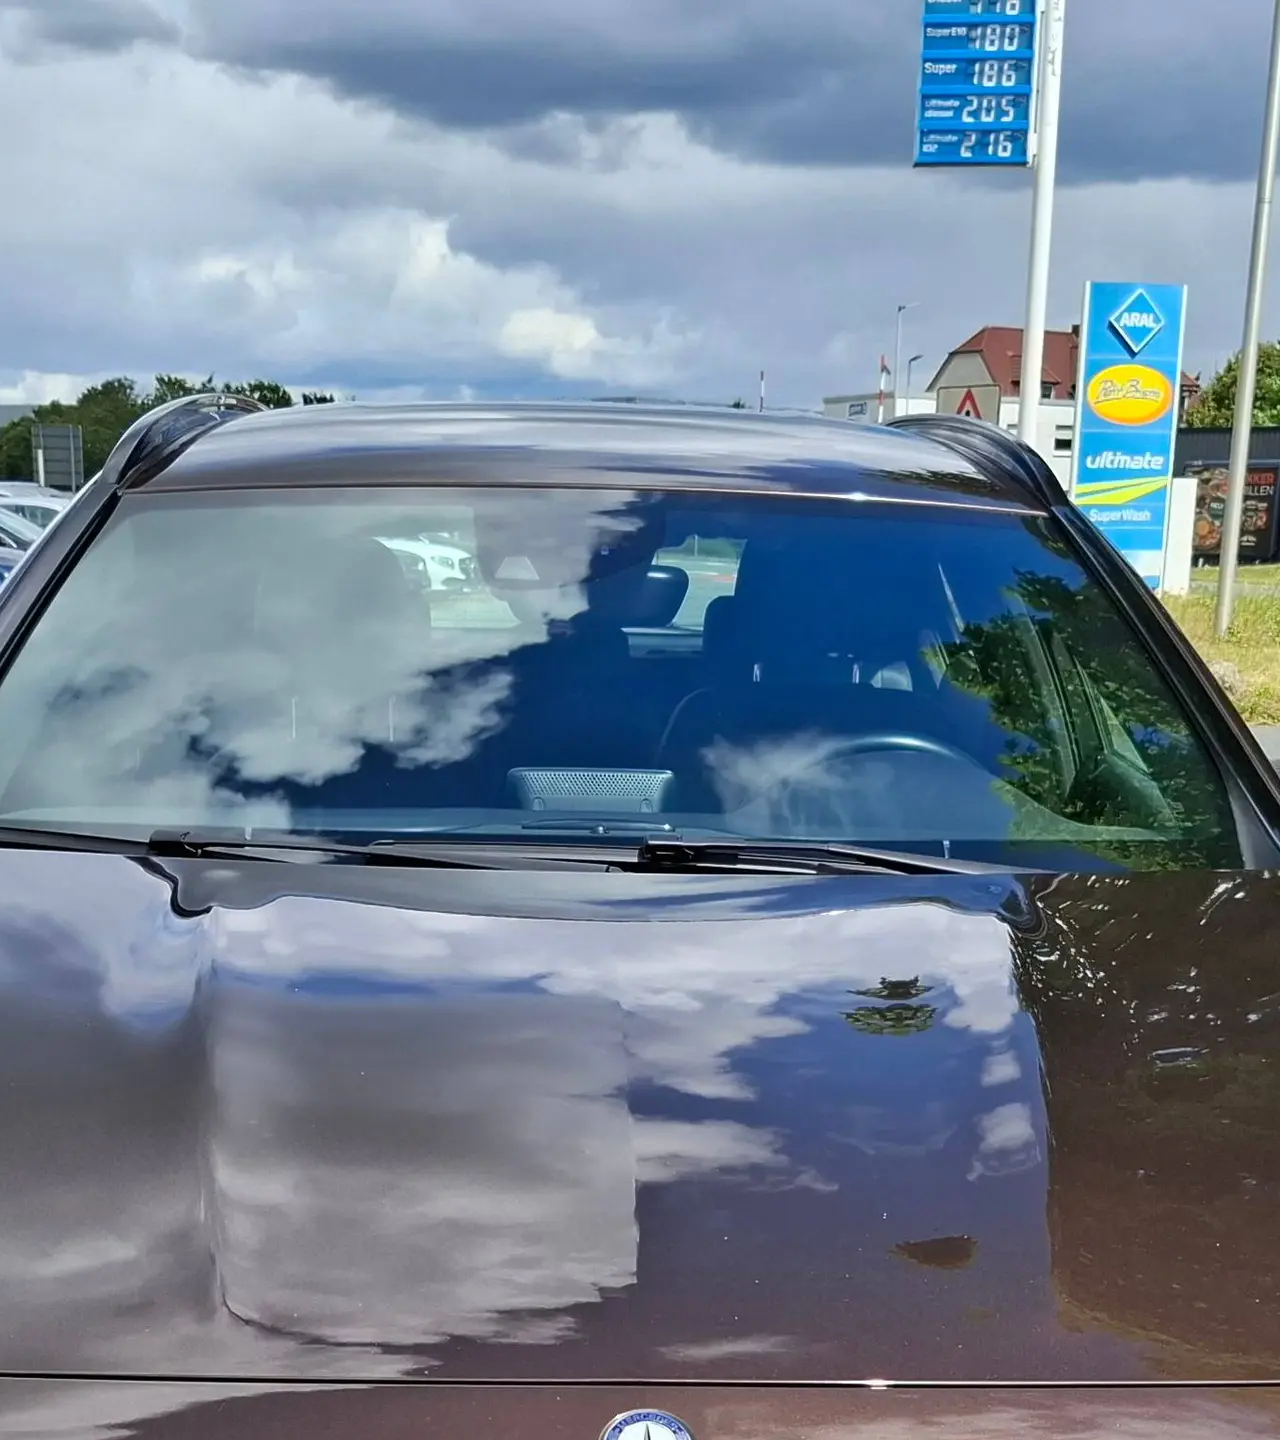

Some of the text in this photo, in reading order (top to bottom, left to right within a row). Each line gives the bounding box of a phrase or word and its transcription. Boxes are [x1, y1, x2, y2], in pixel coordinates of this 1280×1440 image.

[971, 24, 1020, 51] 180
[924, 60, 1017, 87] Super 186
[961, 96, 1015, 123] 205
[960, 131, 1013, 158] 216
[1119, 311, 1158, 328] ARAL
[1085, 451, 1165, 470] ultimate
